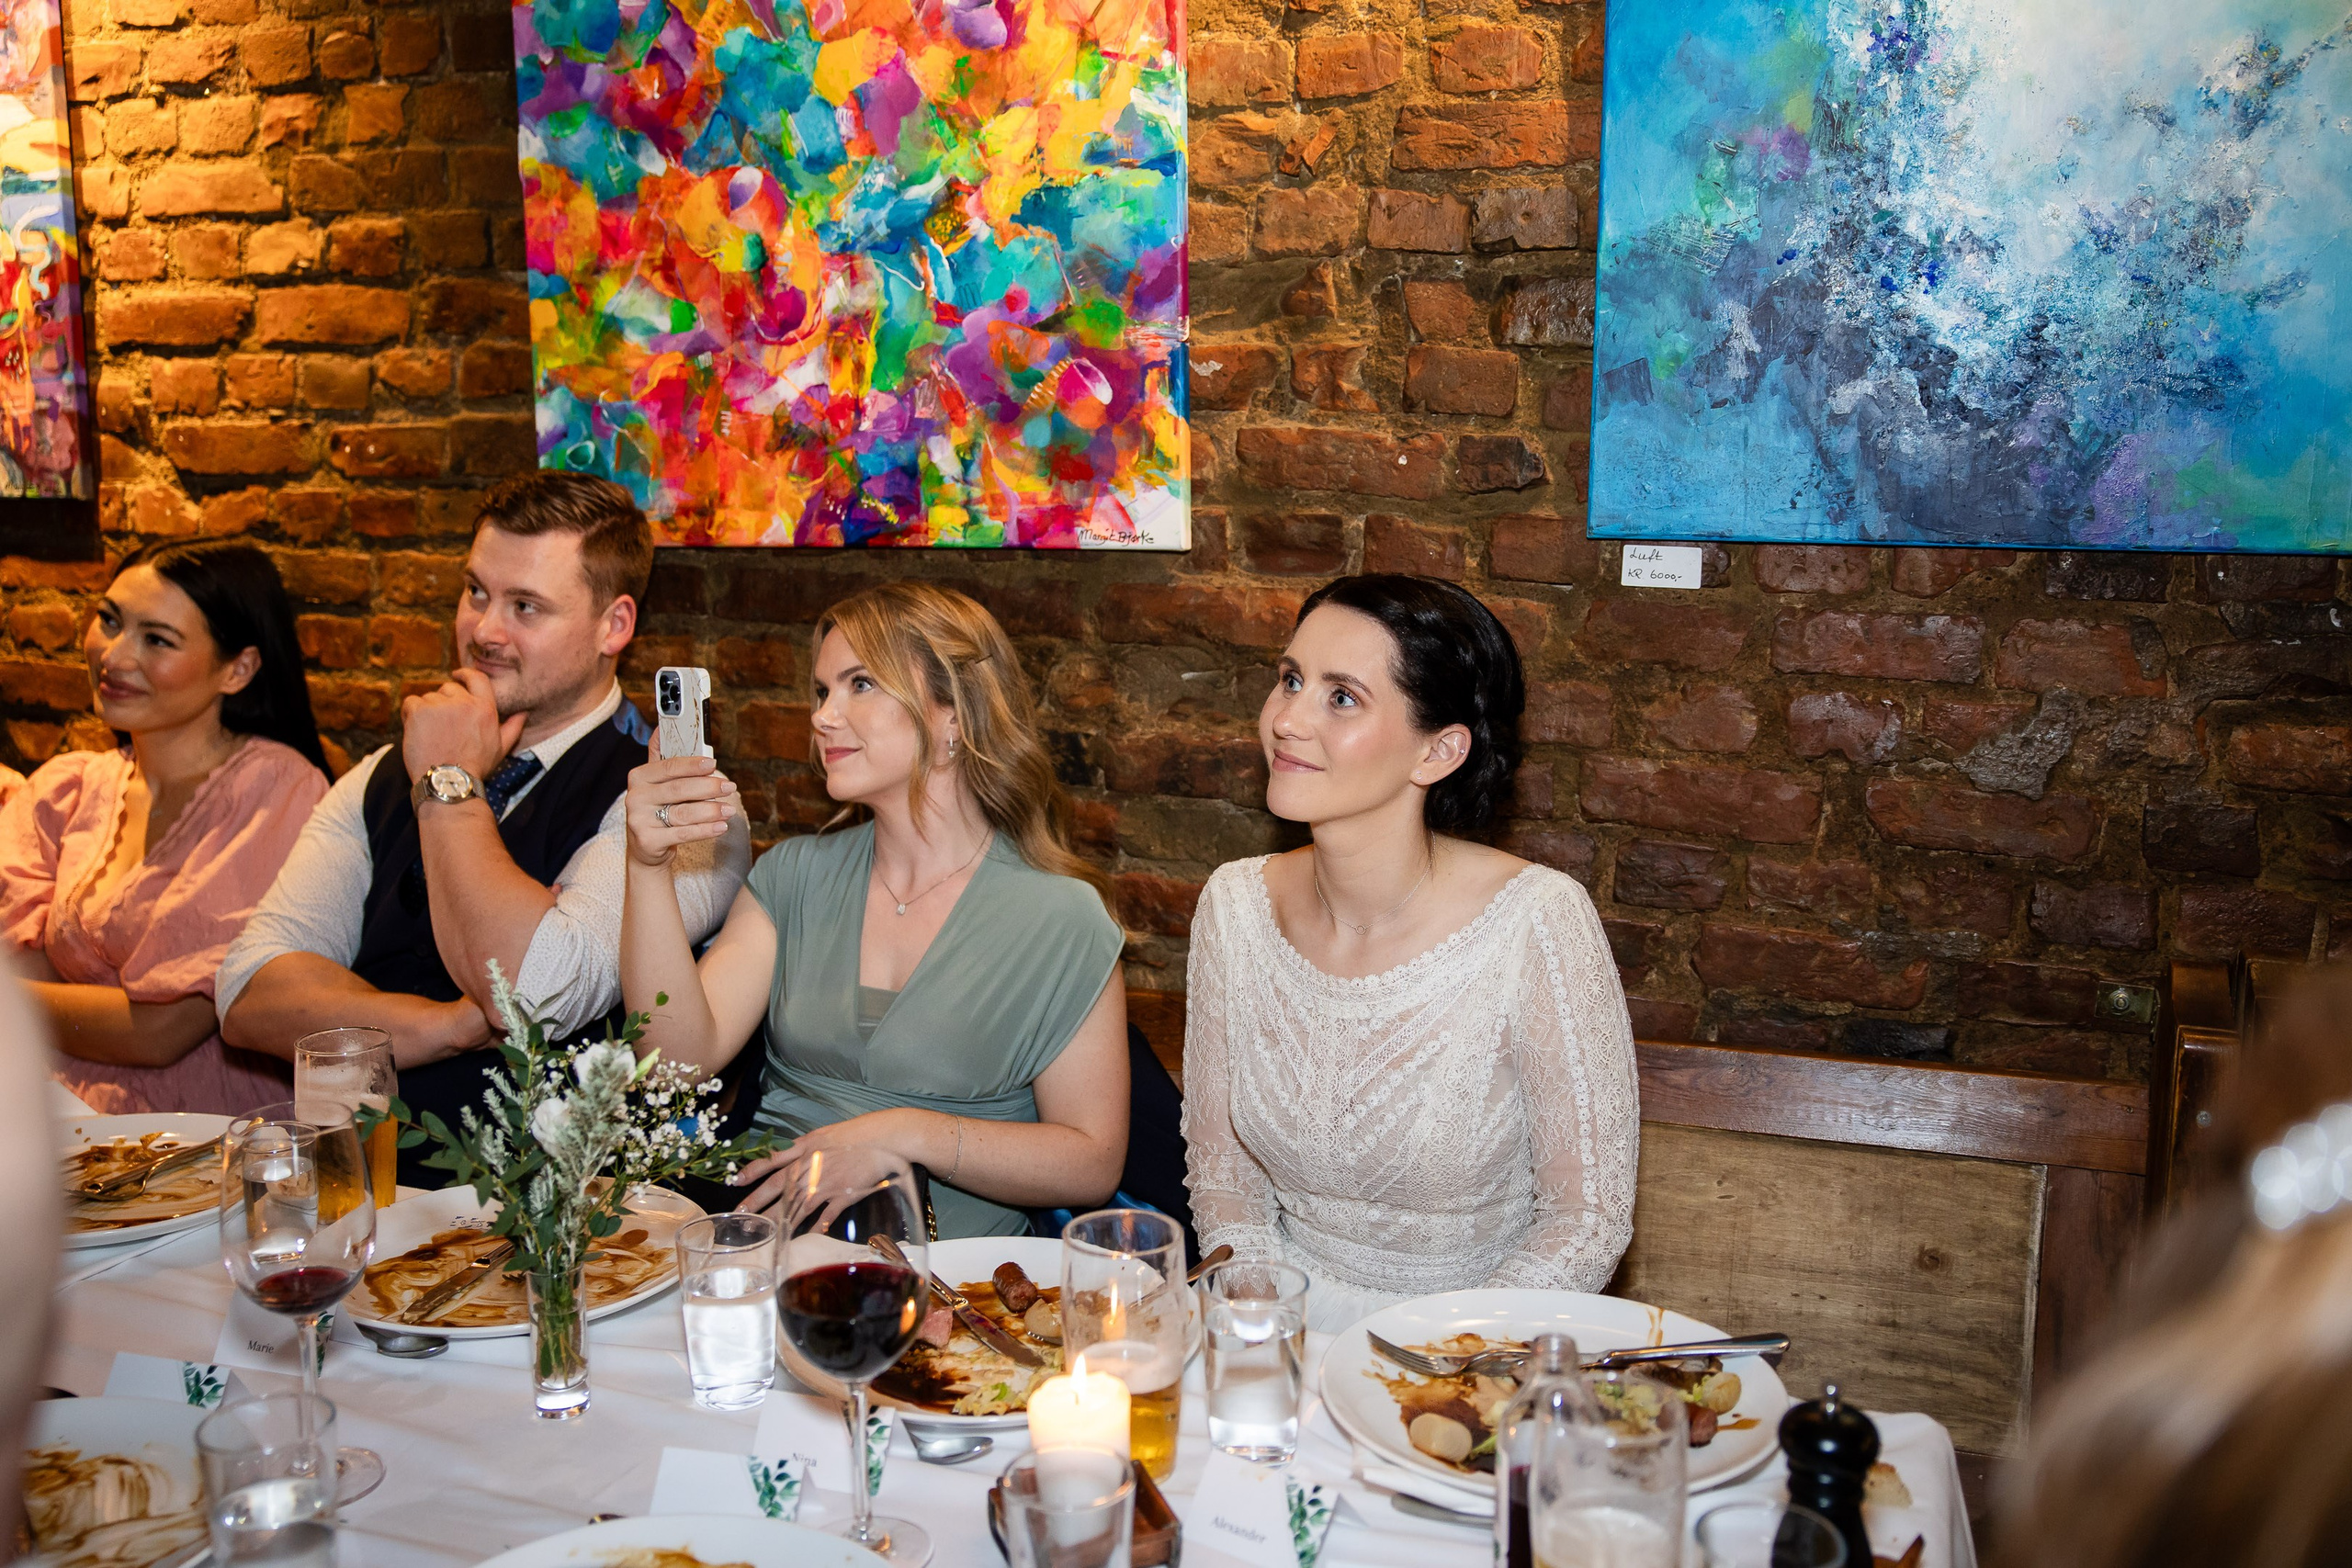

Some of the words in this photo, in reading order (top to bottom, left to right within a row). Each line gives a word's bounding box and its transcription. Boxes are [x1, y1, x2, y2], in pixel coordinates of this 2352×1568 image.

[1078, 528, 1116, 546] Margit
[1630, 547, 1663, 562] Luft
[247, 1340, 274, 1354] Marie
[793, 1452, 817, 1467] Nina
[1212, 1517, 1266, 1543] Alexander
